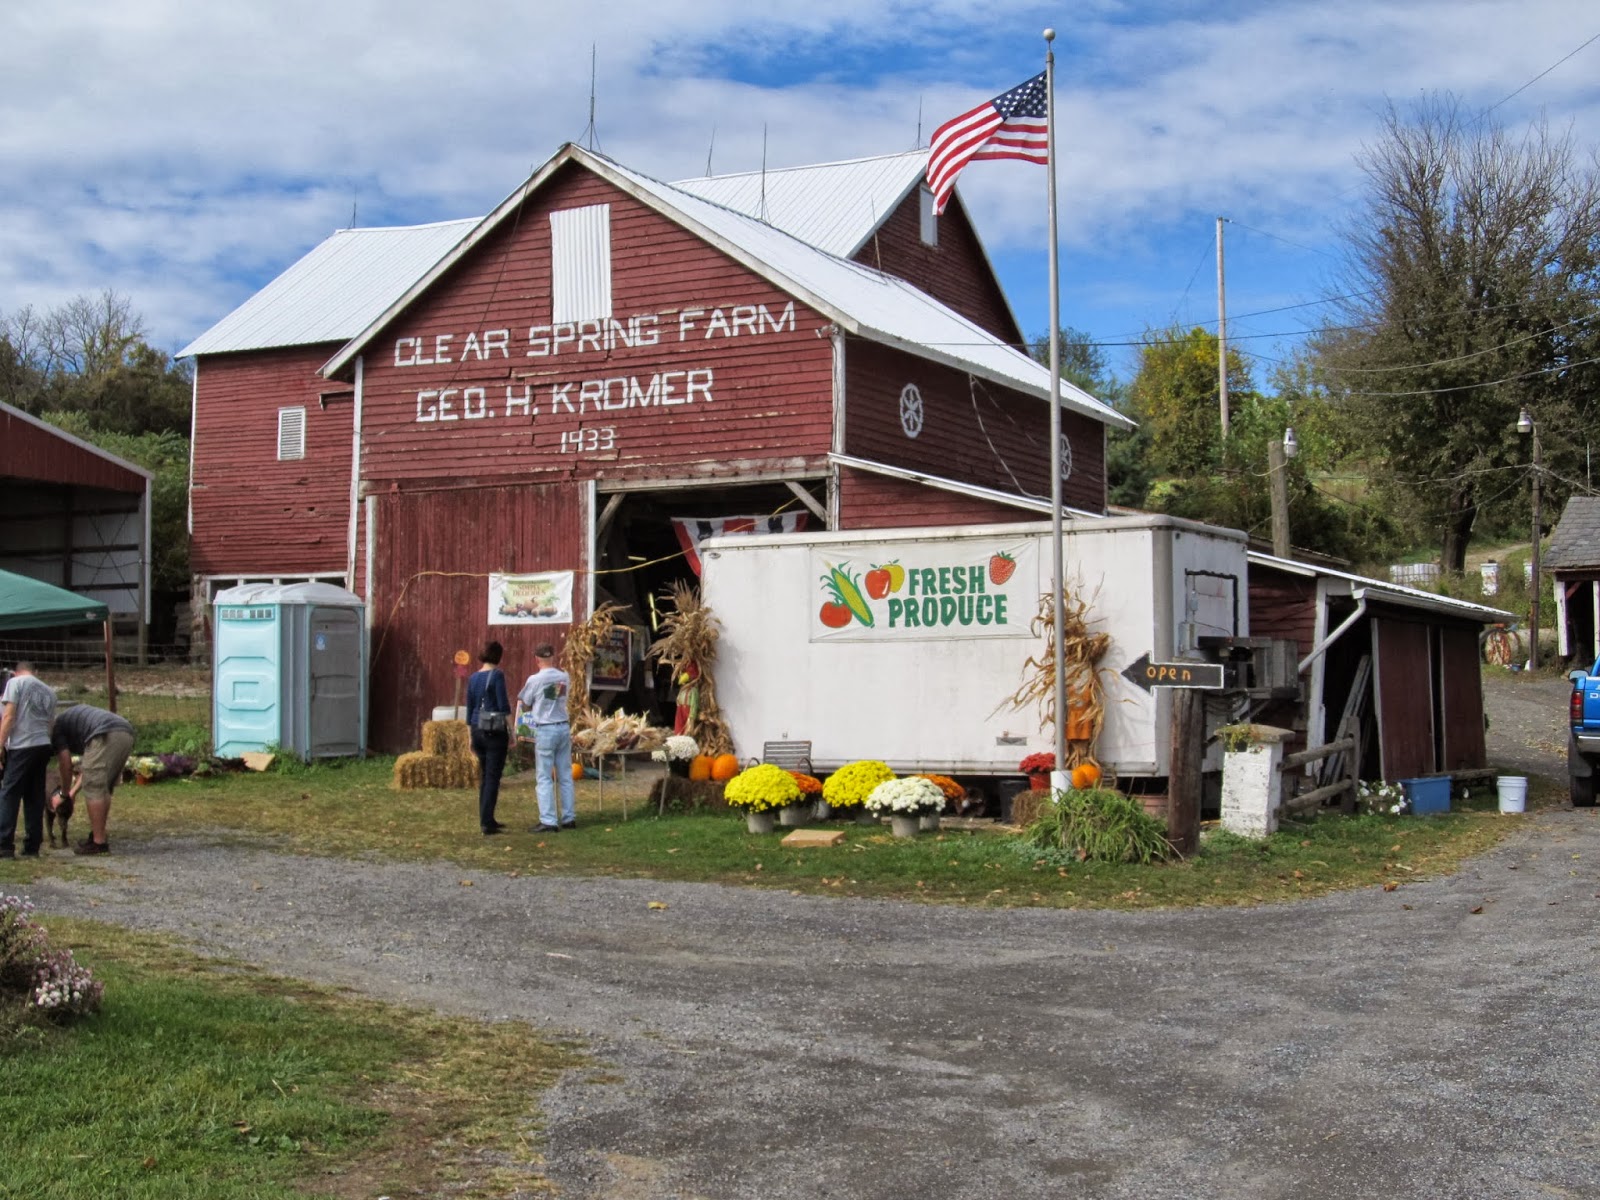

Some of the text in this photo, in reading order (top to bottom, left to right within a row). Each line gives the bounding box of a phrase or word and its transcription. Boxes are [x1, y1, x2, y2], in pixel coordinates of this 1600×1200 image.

[394, 301, 796, 367] CLEAR SPRING FARM
[416, 369, 713, 422] GEO. H. KROMER
[908, 566, 986, 596] FRESH
[888, 594, 1007, 628] PRODUCE
[1146, 666, 1191, 681] open
